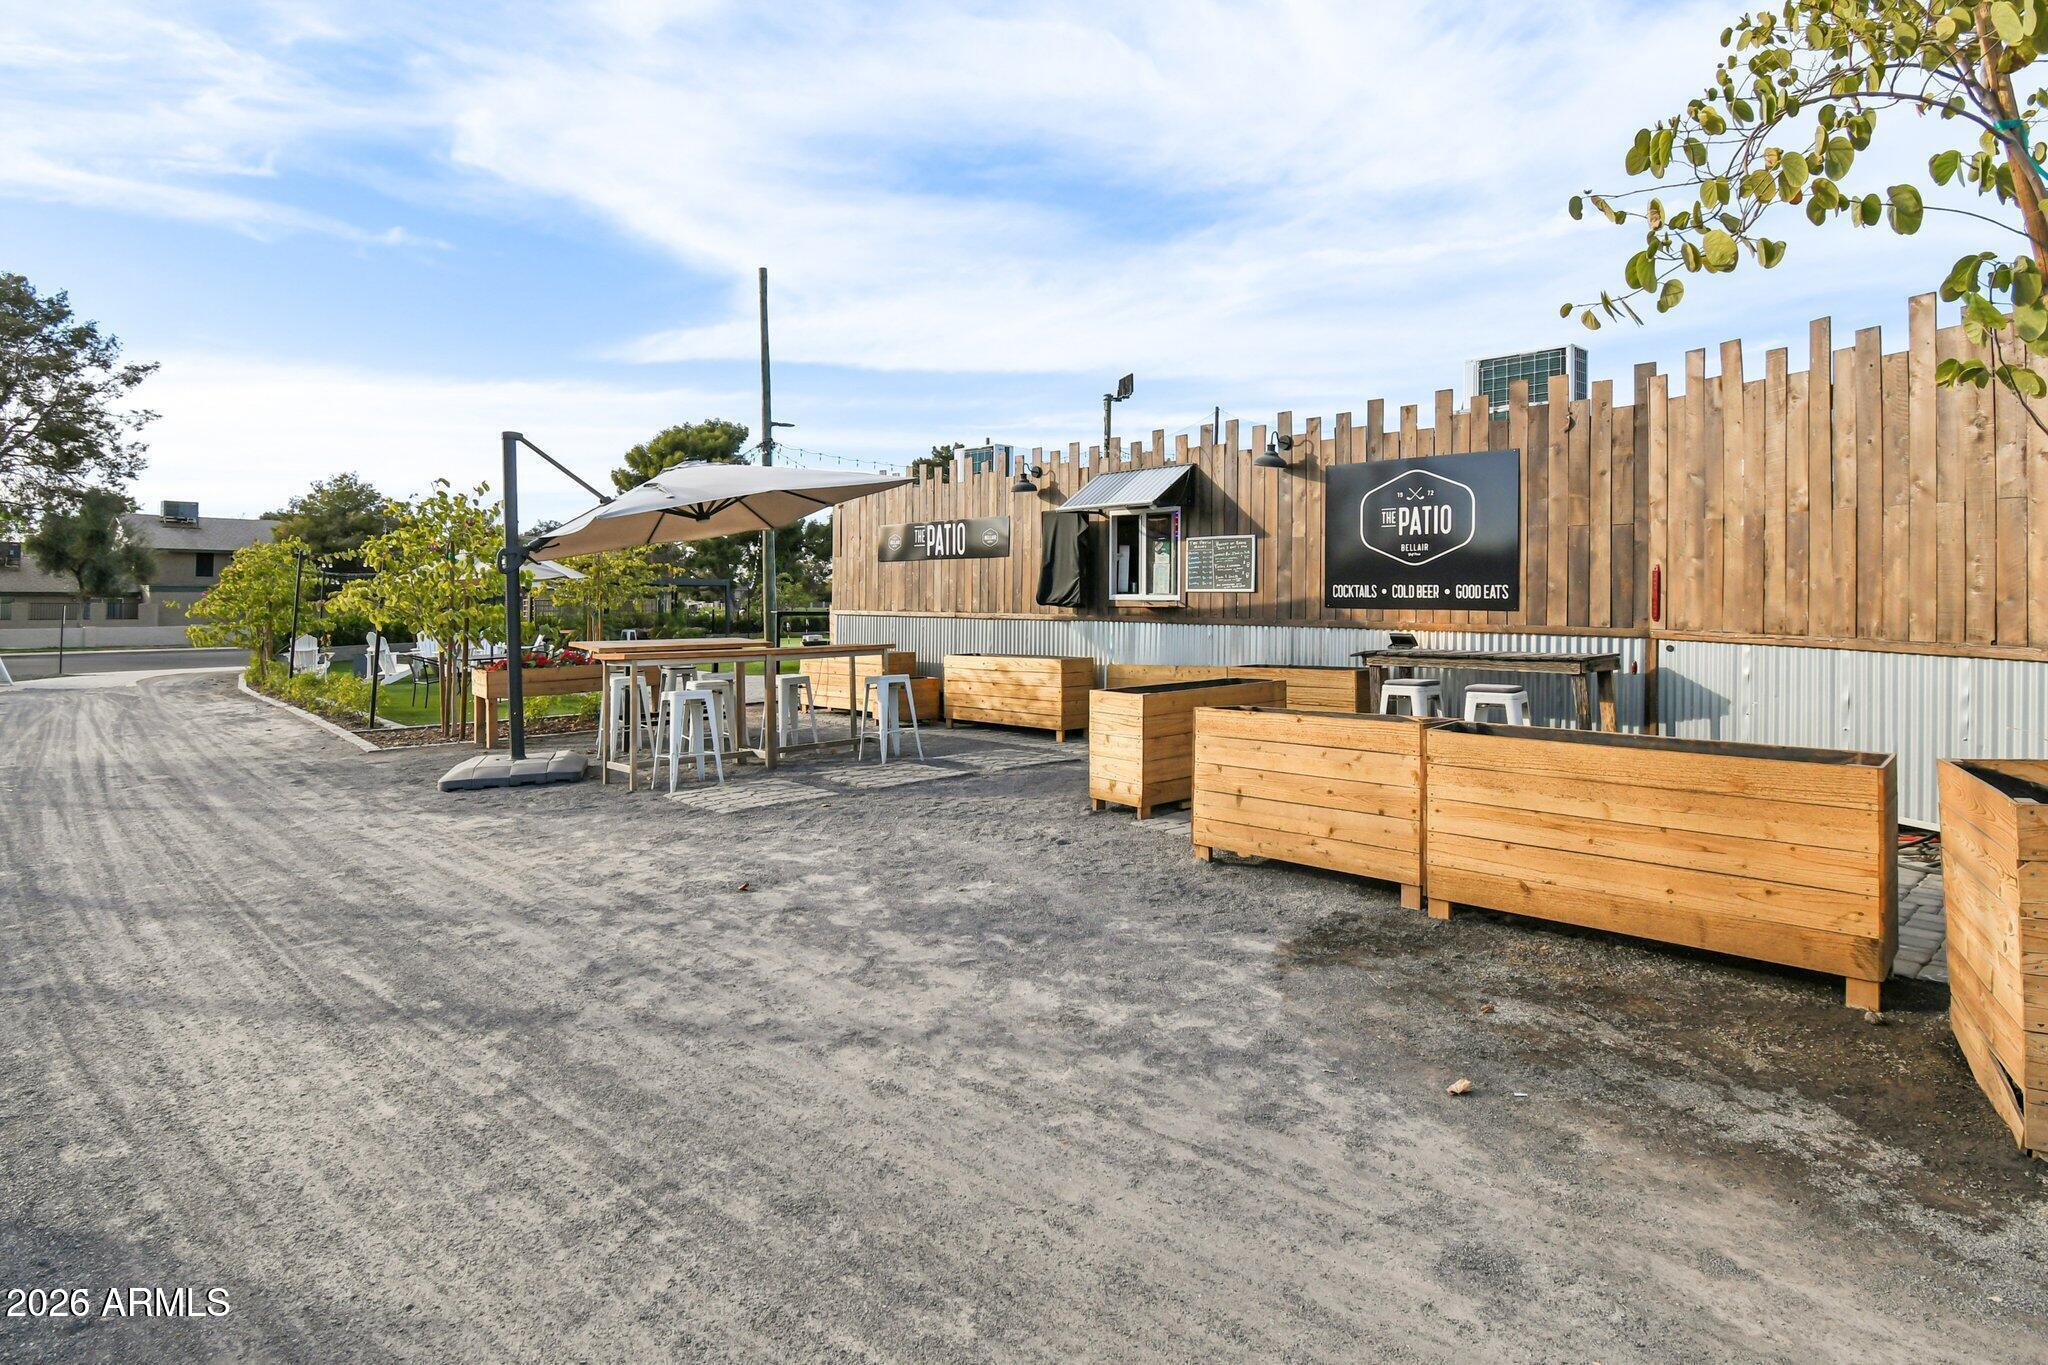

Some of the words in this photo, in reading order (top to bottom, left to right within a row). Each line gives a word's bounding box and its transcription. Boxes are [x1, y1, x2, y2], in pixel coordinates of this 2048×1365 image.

[1381, 511, 1396, 524] THE
[1398, 504, 1452, 536] PATIO
[914, 529, 925, 543] THE
[926, 522, 966, 556] PATIO
[1400, 543, 1429, 552] BELLAIR
[1332, 584, 1377, 598] COCKTAILS
[1391, 584, 1415, 599] COLD
[1416, 584, 1440, 599] BEER
[1455, 584, 1482, 599] GOOD
[1483, 584, 1509, 600] EATS
